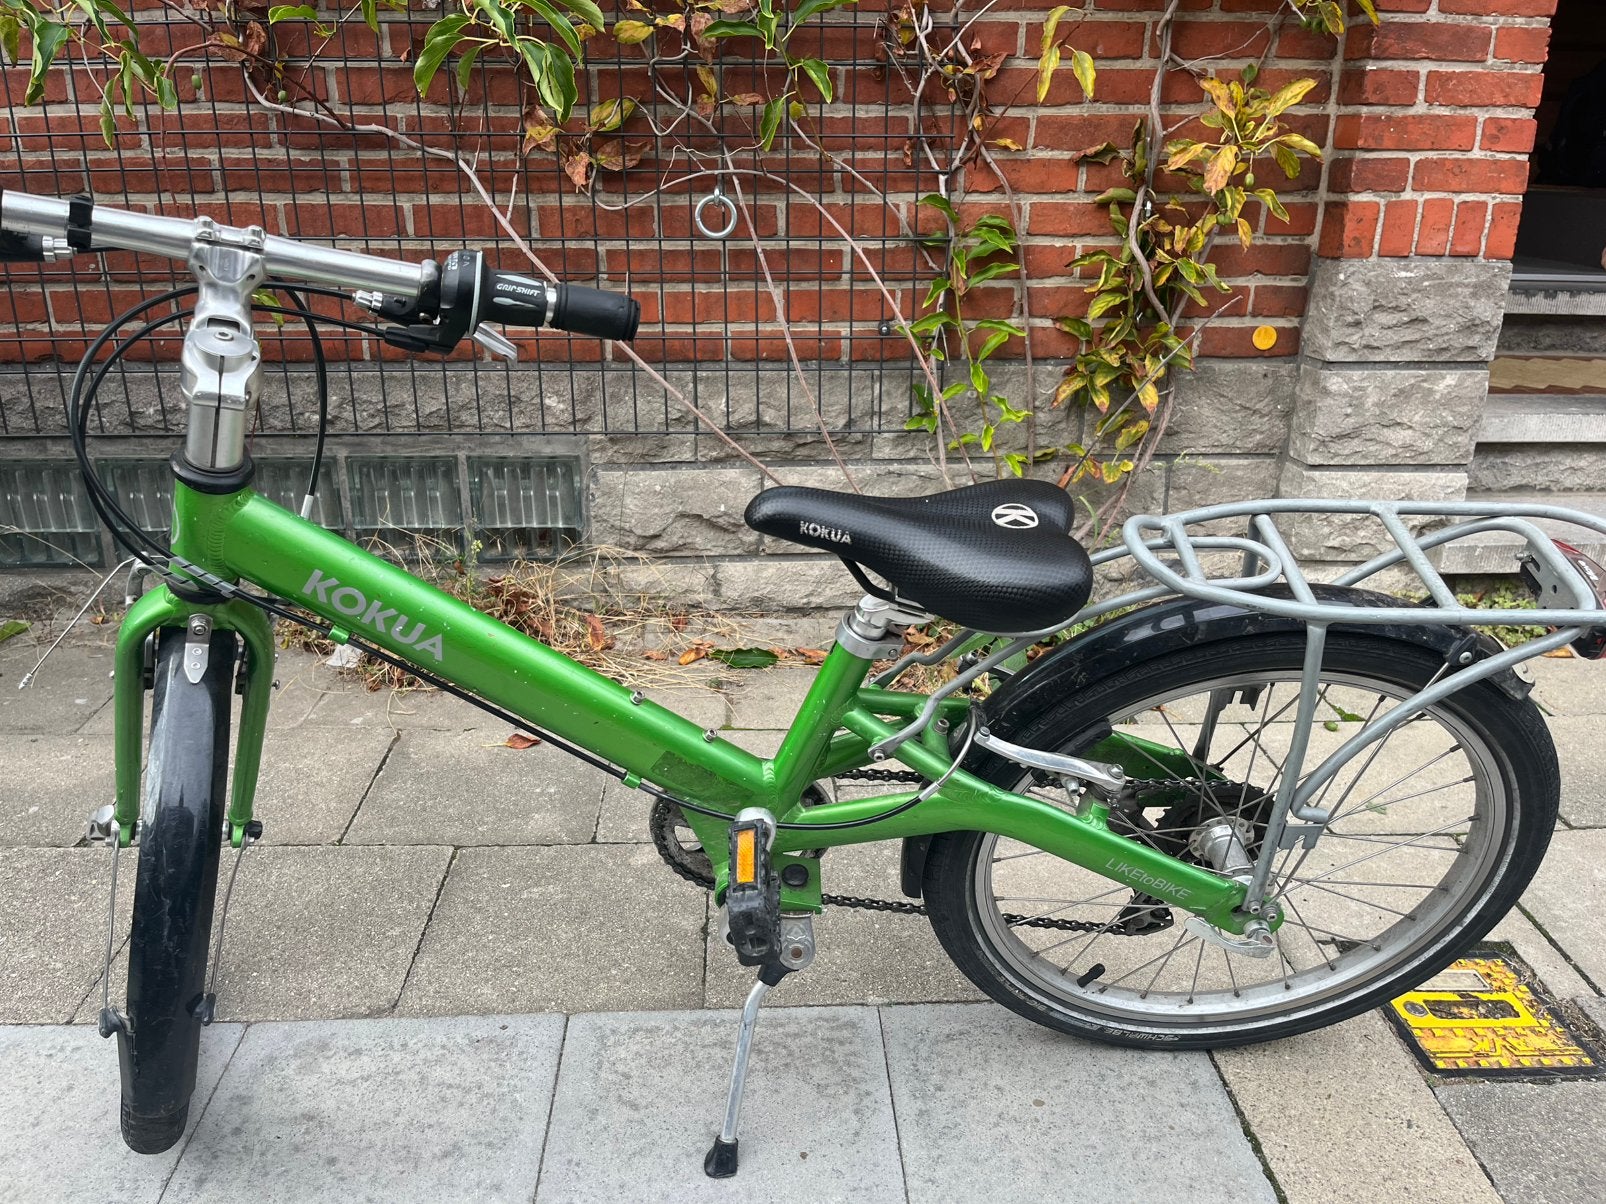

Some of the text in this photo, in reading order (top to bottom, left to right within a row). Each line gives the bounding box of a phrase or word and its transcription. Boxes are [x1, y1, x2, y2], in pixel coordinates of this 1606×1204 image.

[800, 520, 852, 545] KOKUA
[302, 569, 443, 662] KOKUA
[1105, 858, 1192, 899] LIKEtoBIKE
[1104, 1028, 1179, 1041] SCHWALBE
